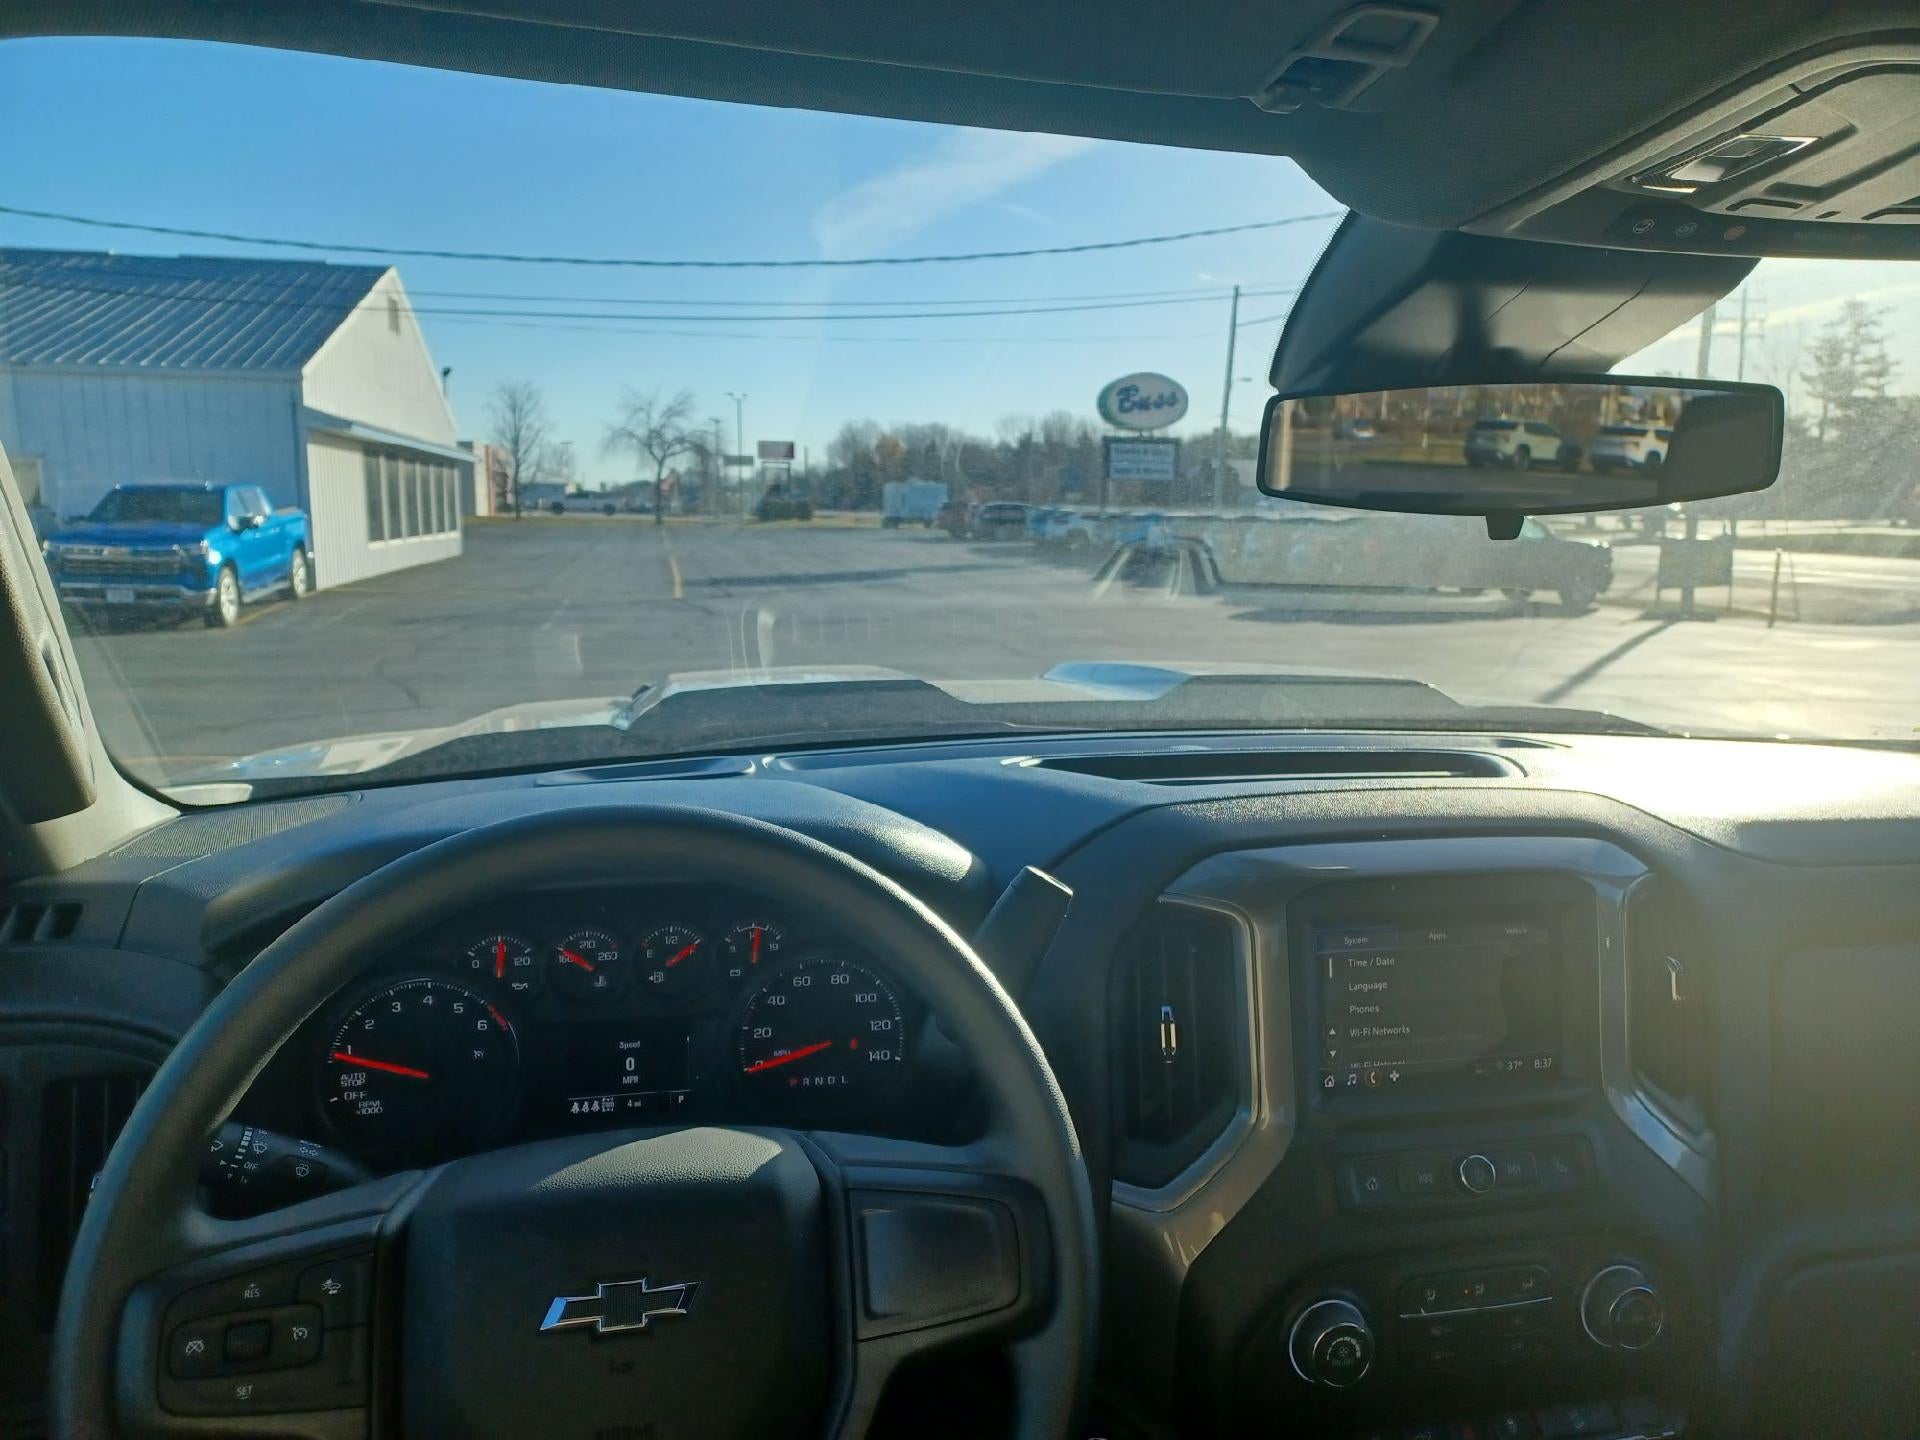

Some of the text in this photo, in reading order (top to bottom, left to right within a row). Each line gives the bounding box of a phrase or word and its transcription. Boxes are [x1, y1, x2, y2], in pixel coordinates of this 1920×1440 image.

[579, 940, 596, 949] 210
[664, 935, 679, 945] 1/2
[597, 951, 618, 961] 260
[646, 949, 653, 959] E
[471, 959, 480, 969] 0
[513, 957, 531, 966] 120
[1348, 959, 1368, 968] Time
[1375, 957, 1395, 966] Date
[792, 976, 811, 987] 60
[830, 974, 850, 985] 80
[1348, 981, 1388, 993] Language
[422, 995, 433, 1005] 4
[767, 995, 785, 1006] 40
[855, 993, 877, 1003] 100
[391, 1002, 401, 1013] 3
[453, 1003, 464, 1014] 5
[1349, 1005, 1380, 1014] Phones
[364, 1020, 375, 1030] 2
[477, 1020, 488, 1031] 6
[870, 1019, 891, 1031] 120
[753, 1026, 772, 1039] 20
[1350, 1025, 1410, 1037] Wi-Fi Networks
[868, 1050, 890, 1062] 140
[625, 1057, 635, 1071] 0
[1534, 1057, 1552, 1069] 8:37
[341, 1072, 366, 1080] AUTO
[622, 1075, 639, 1085] MPH
[802, 1078, 810, 1087] R
[815, 1077, 824, 1086] N
[827, 1076, 836, 1085] D
[841, 1075, 848, 1084] L
[340, 1079, 366, 1087] STOP
[344, 1091, 367, 1101] OFF
[236, 1385, 254, 1397] SET
